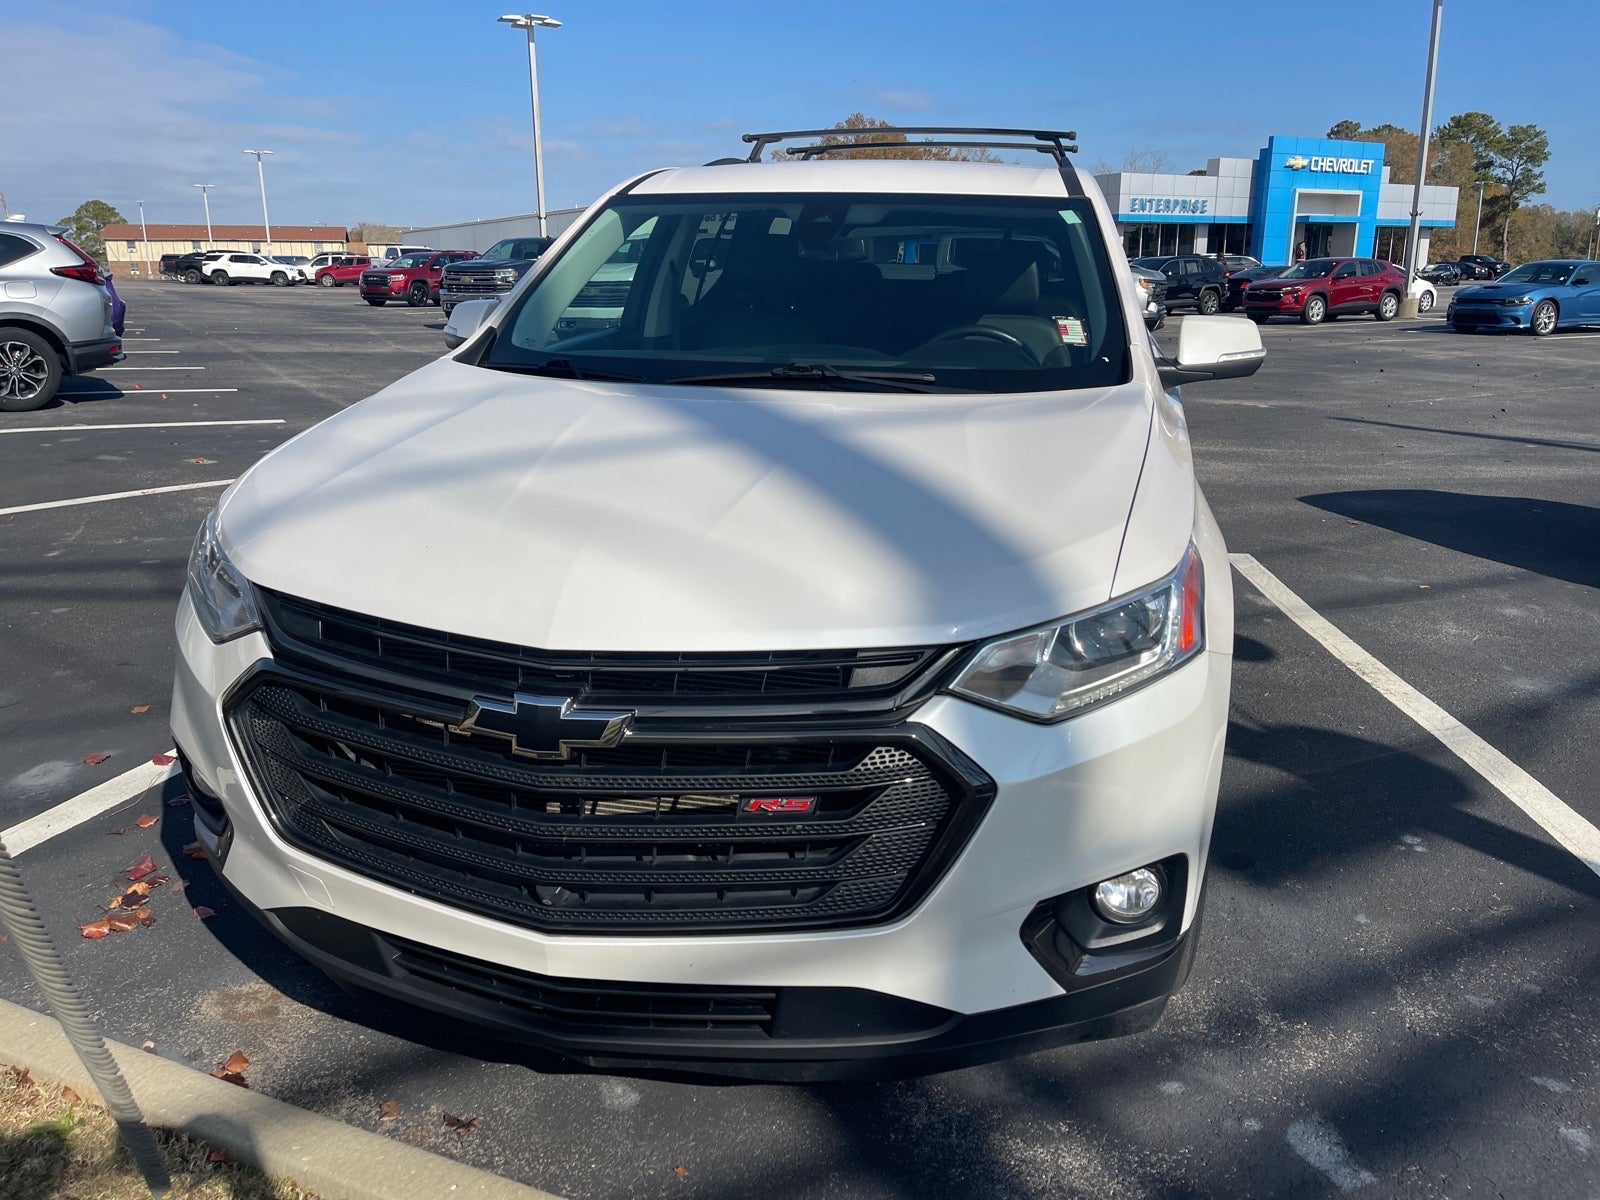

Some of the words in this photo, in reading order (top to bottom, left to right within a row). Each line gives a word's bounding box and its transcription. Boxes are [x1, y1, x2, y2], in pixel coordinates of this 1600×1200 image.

[1310, 156, 1374, 174] CHEVROLET
[1130, 197, 1208, 214] ENTERPRISE
[743, 797, 814, 812] RS
